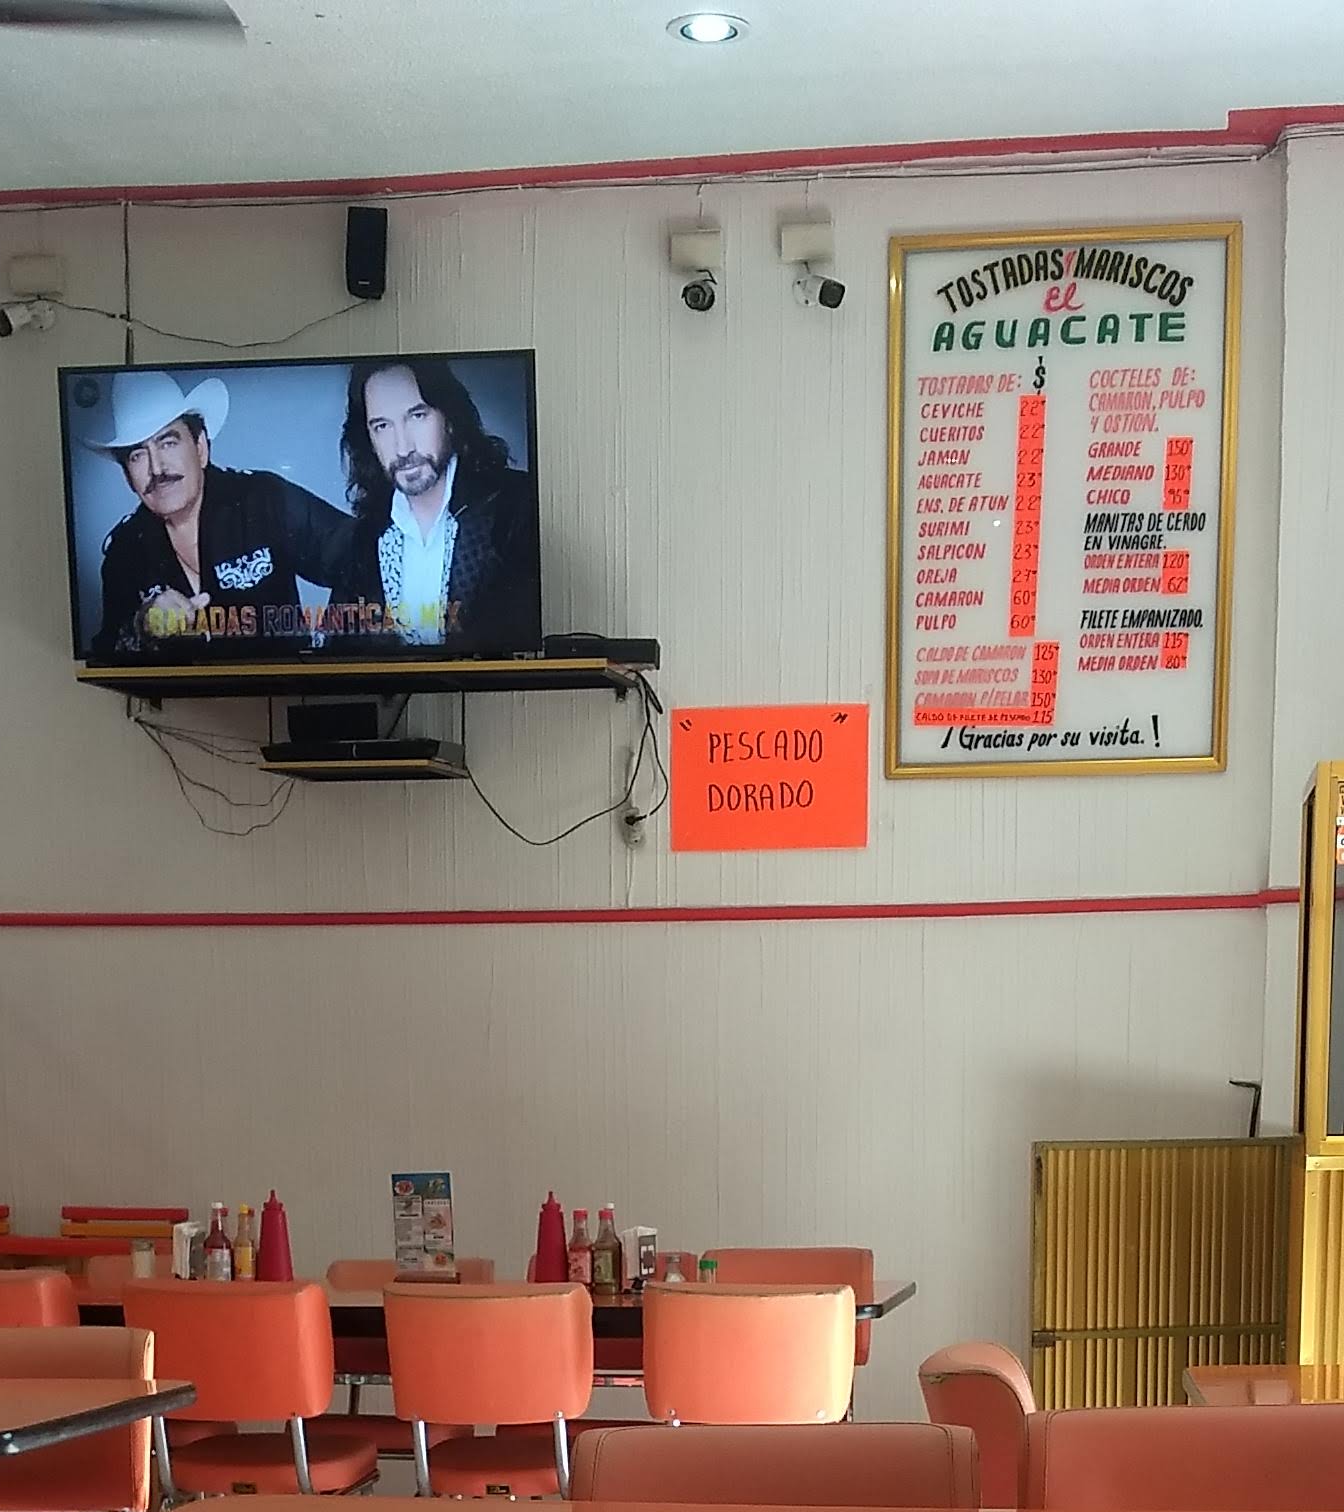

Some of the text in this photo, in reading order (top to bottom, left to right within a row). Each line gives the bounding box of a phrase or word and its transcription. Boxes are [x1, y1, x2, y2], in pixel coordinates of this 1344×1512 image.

[936, 248, 1064, 313] TOSTADAS
[1073, 247, 1194, 307] MARISCOS
[932, 312, 1185, 351] AGUACATE
[918, 374, 1022, 397] TOSTADAS DE:
[1089, 367, 1196, 388] COCTELES DE:
[1159, 390, 1205, 409] PULPO
[920, 402, 985, 418] CEVICHE
[920, 425, 985, 442] CUERITOS
[918, 450, 971, 466] JAMON
[1088, 441, 1142, 458] GRANDE
[917, 473, 982, 490] AGUACATE
[1086, 465, 1154, 482] MEDIANO
[948, 497, 966, 513] DE
[968, 495, 1009, 511] ATUN
[1086, 489, 1130, 505] CHICO
[918, 521, 970, 537] SURIMI
[1084, 512, 1206, 533] MANITAS DE CERDO
[1084, 535, 1167, 550] EN VINAGRE.
[917, 543, 986, 560] SALPICON
[1084, 554, 1115, 569] ORDEN
[1116, 553, 1159, 569] ENTERA
[916, 568, 957, 584] OREJA
[1082, 578, 1120, 594] MEDIA
[1122, 577, 1161, 593] ORDEN
[915, 591, 984, 607] CAMARON
[915, 614, 957, 630] PULPO
[1080, 609, 1203, 629] FILETE EMPANIZADO.
[1079, 634, 1116, 648] ORDEN
[1117, 633, 1159, 648] ENTERA
[1078, 656, 1115, 671] MEDIA
[1118, 656, 1158, 670] ORDEN
[708, 728, 823, 763] PESCADO
[1027, 733, 1057, 751] por
[1061, 732, 1081, 746] su
[708, 780, 814, 812] DORADO
